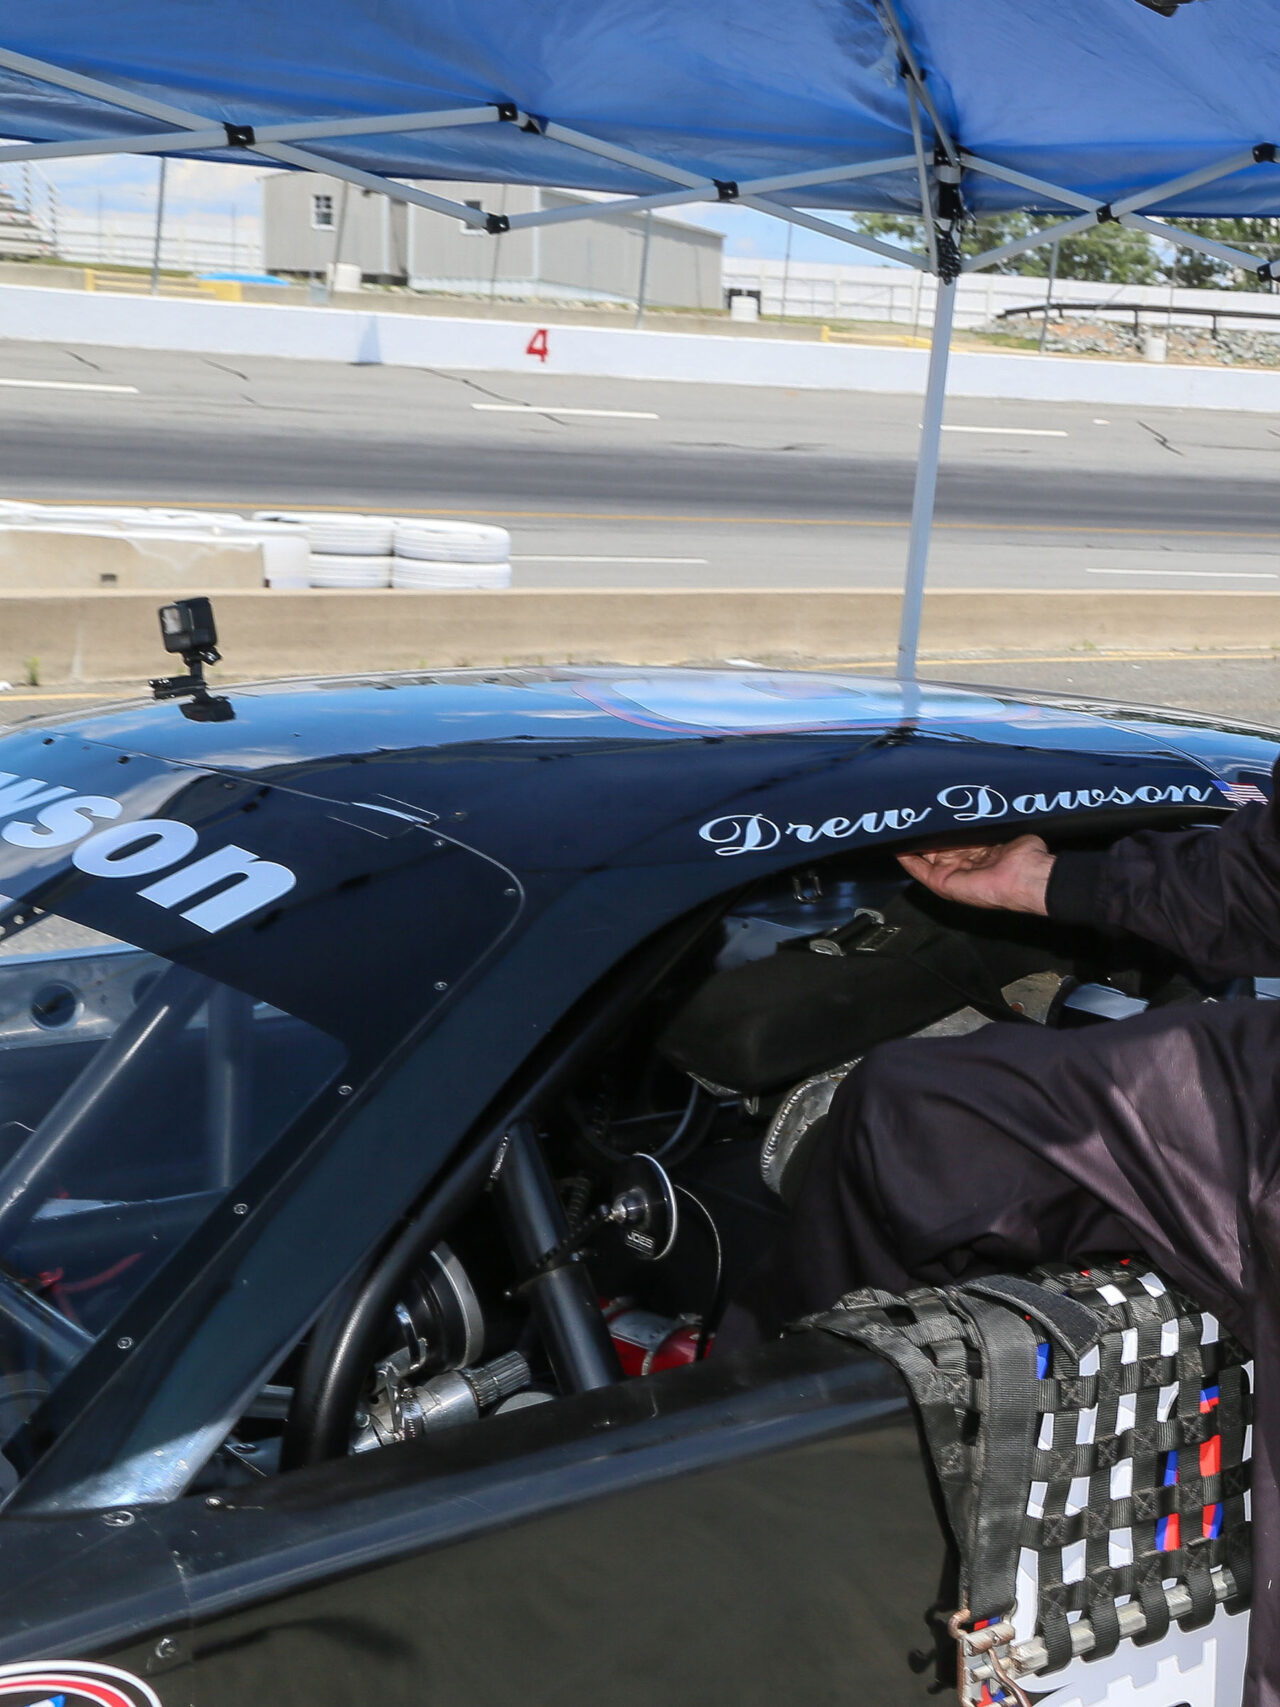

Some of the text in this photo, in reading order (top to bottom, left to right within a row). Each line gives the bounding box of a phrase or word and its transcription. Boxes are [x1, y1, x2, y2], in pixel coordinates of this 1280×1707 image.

[526, 328, 548, 363] 4
[699, 784, 1213, 857] Drew Dawson
